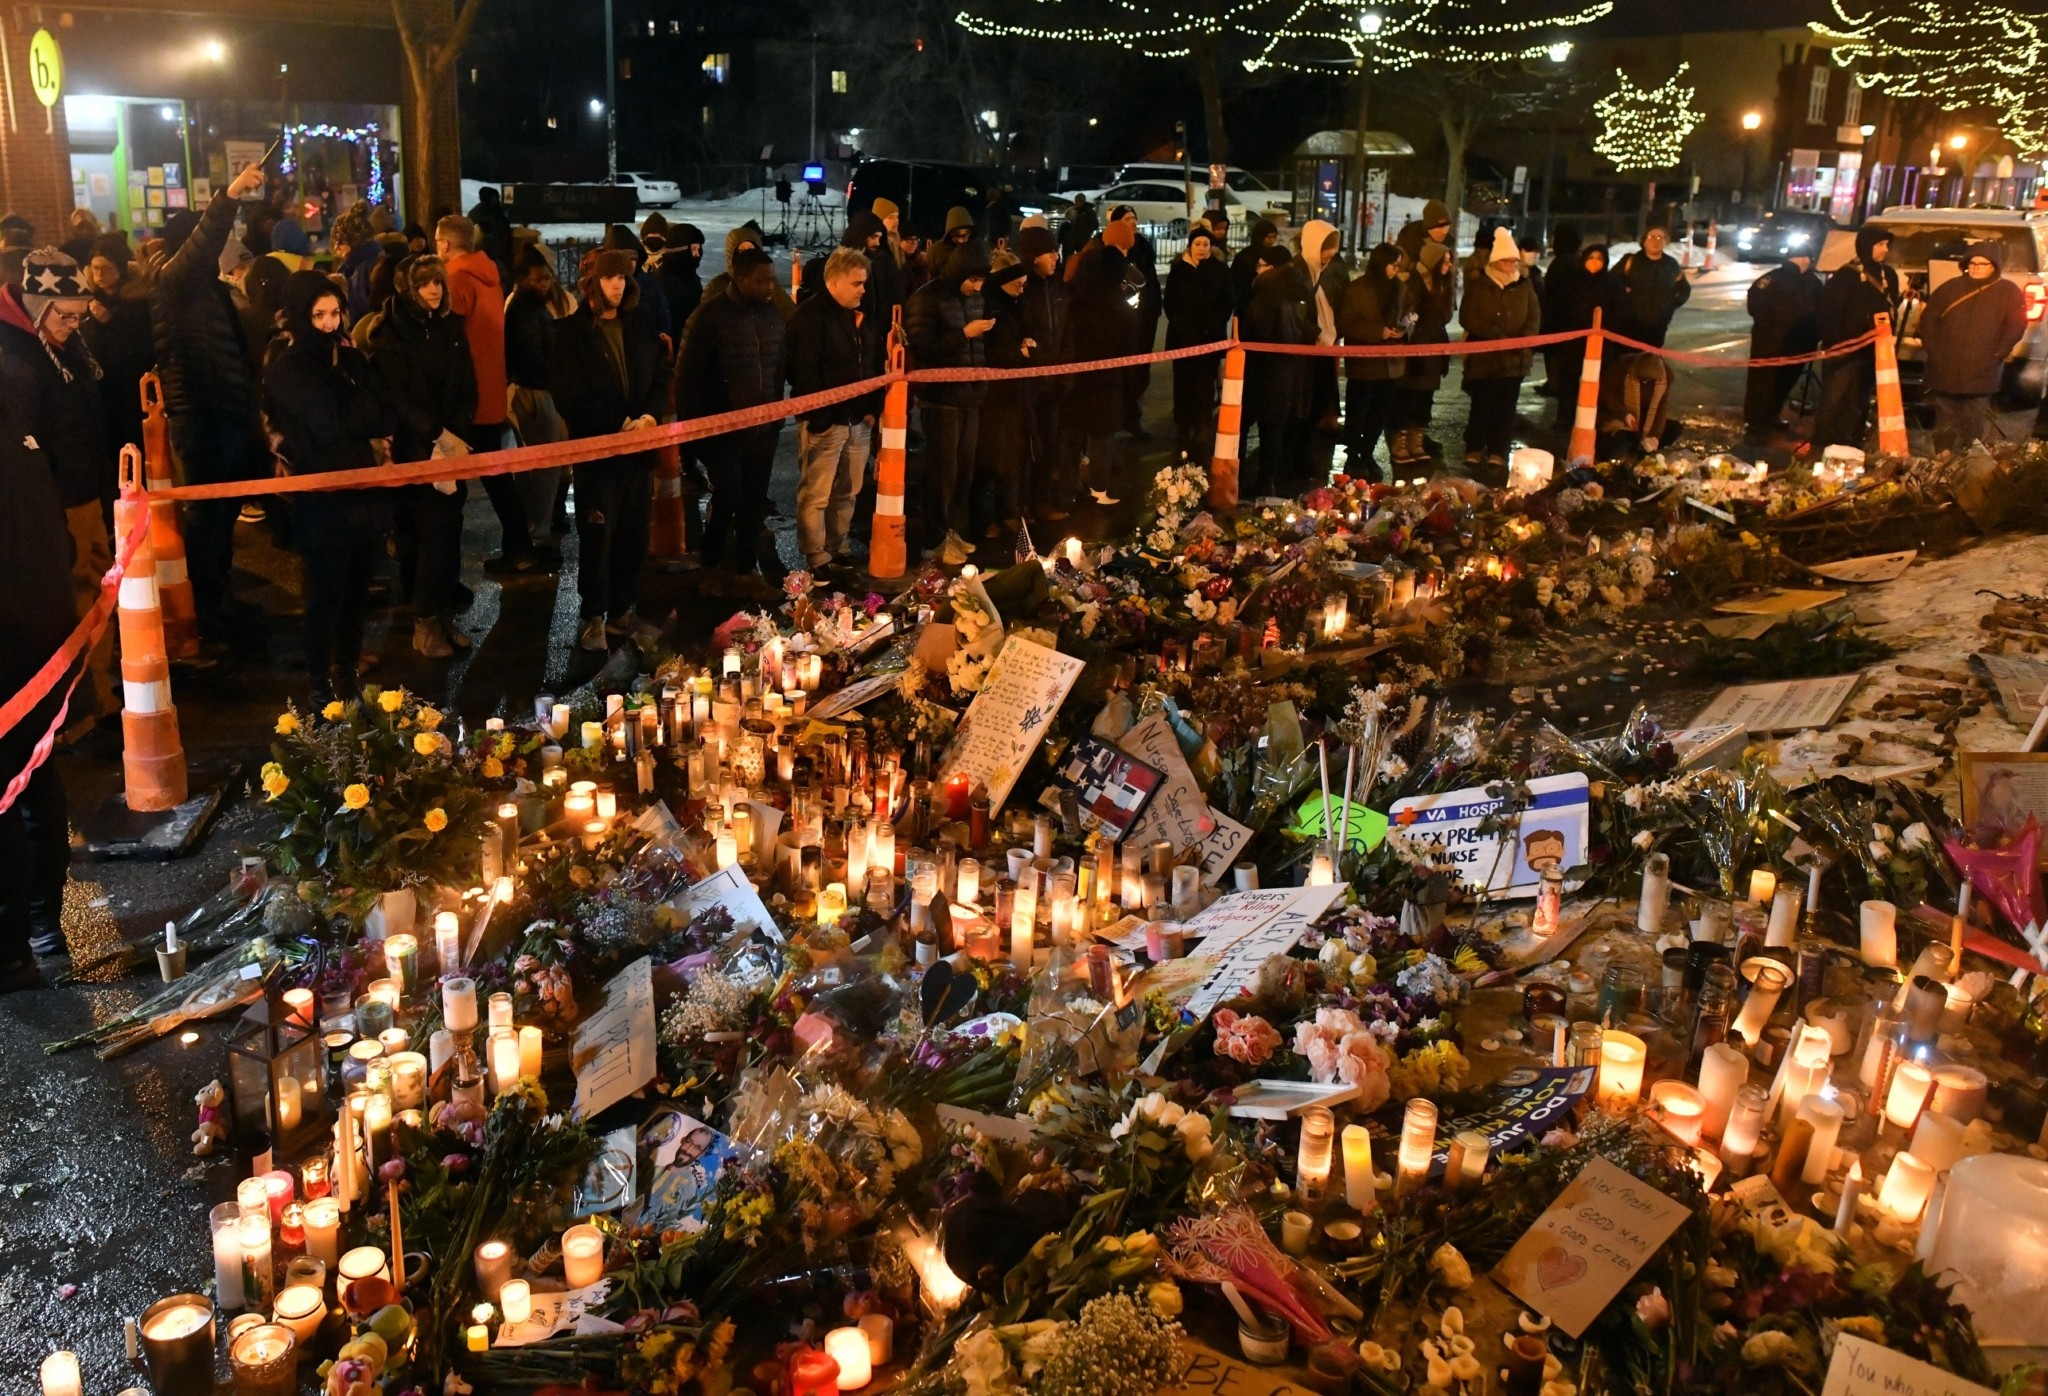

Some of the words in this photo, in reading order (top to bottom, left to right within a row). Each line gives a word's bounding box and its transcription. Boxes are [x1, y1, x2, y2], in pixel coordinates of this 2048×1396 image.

[1426, 808, 1447, 821] VA
[1431, 848, 1479, 865] NURSE
[1240, 902, 1281, 914] Killing
[1436, 1087, 1533, 1133] ABOLISH
[1507, 1078, 1566, 1118] LOVE
[1529, 1096, 1568, 1121] DO
[1561, 1225, 1588, 1246] GOOD
[1592, 1244, 1632, 1271] CITIZEN
[1579, 1207, 1615, 1231] GOOD
[1619, 1229, 1650, 1252] MAN
[1183, 1354, 1245, 1396] BE
[1845, 1345, 1876, 1382] You
[1883, 1372, 1914, 1396] who
